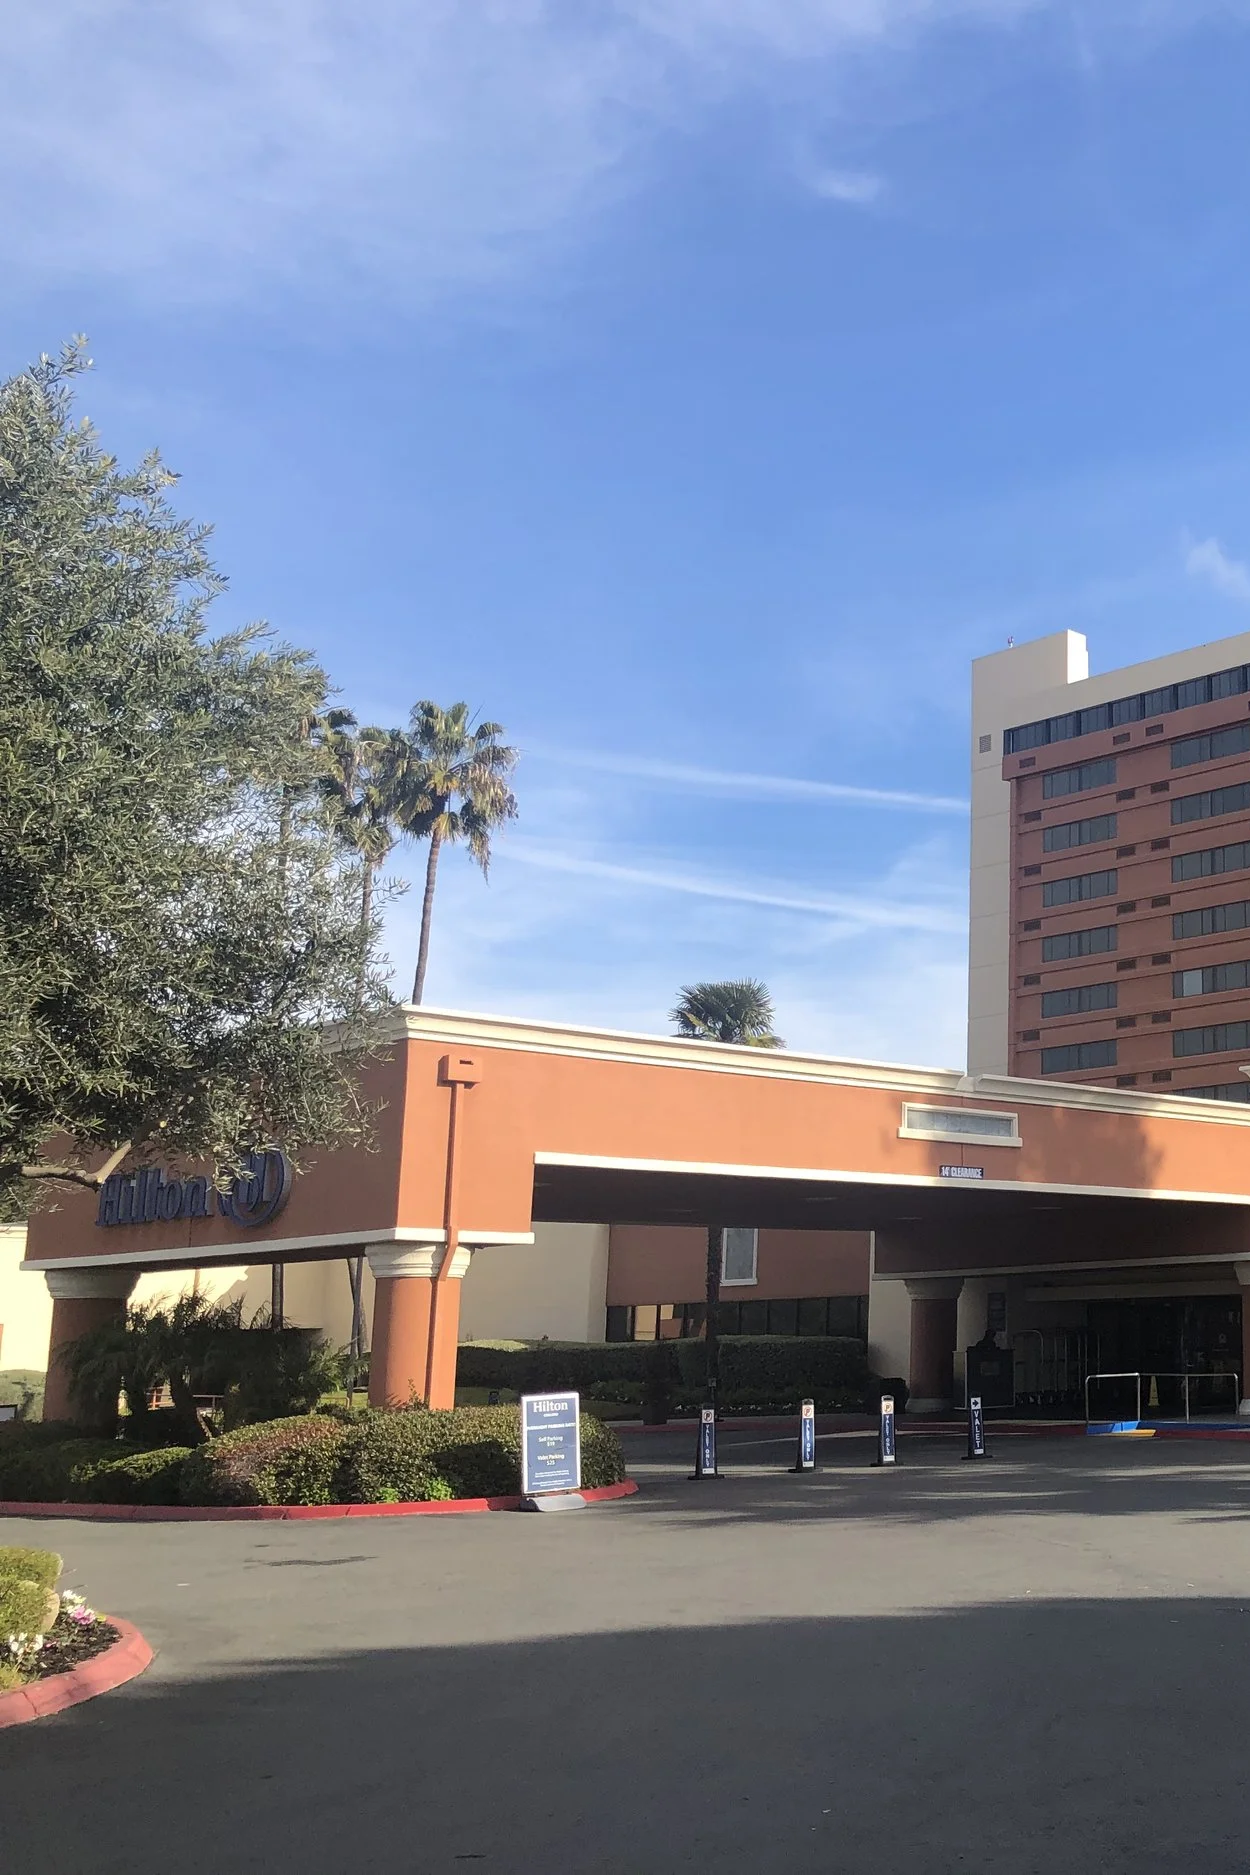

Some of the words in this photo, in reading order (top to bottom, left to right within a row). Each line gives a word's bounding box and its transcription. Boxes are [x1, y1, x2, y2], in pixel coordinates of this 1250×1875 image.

[950, 1167, 983, 1178] CLEARANCE
[95, 1167, 212, 1227] Hilton
[533, 1401, 568, 1412] Hilton
[973, 1410, 981, 1448] VALET
